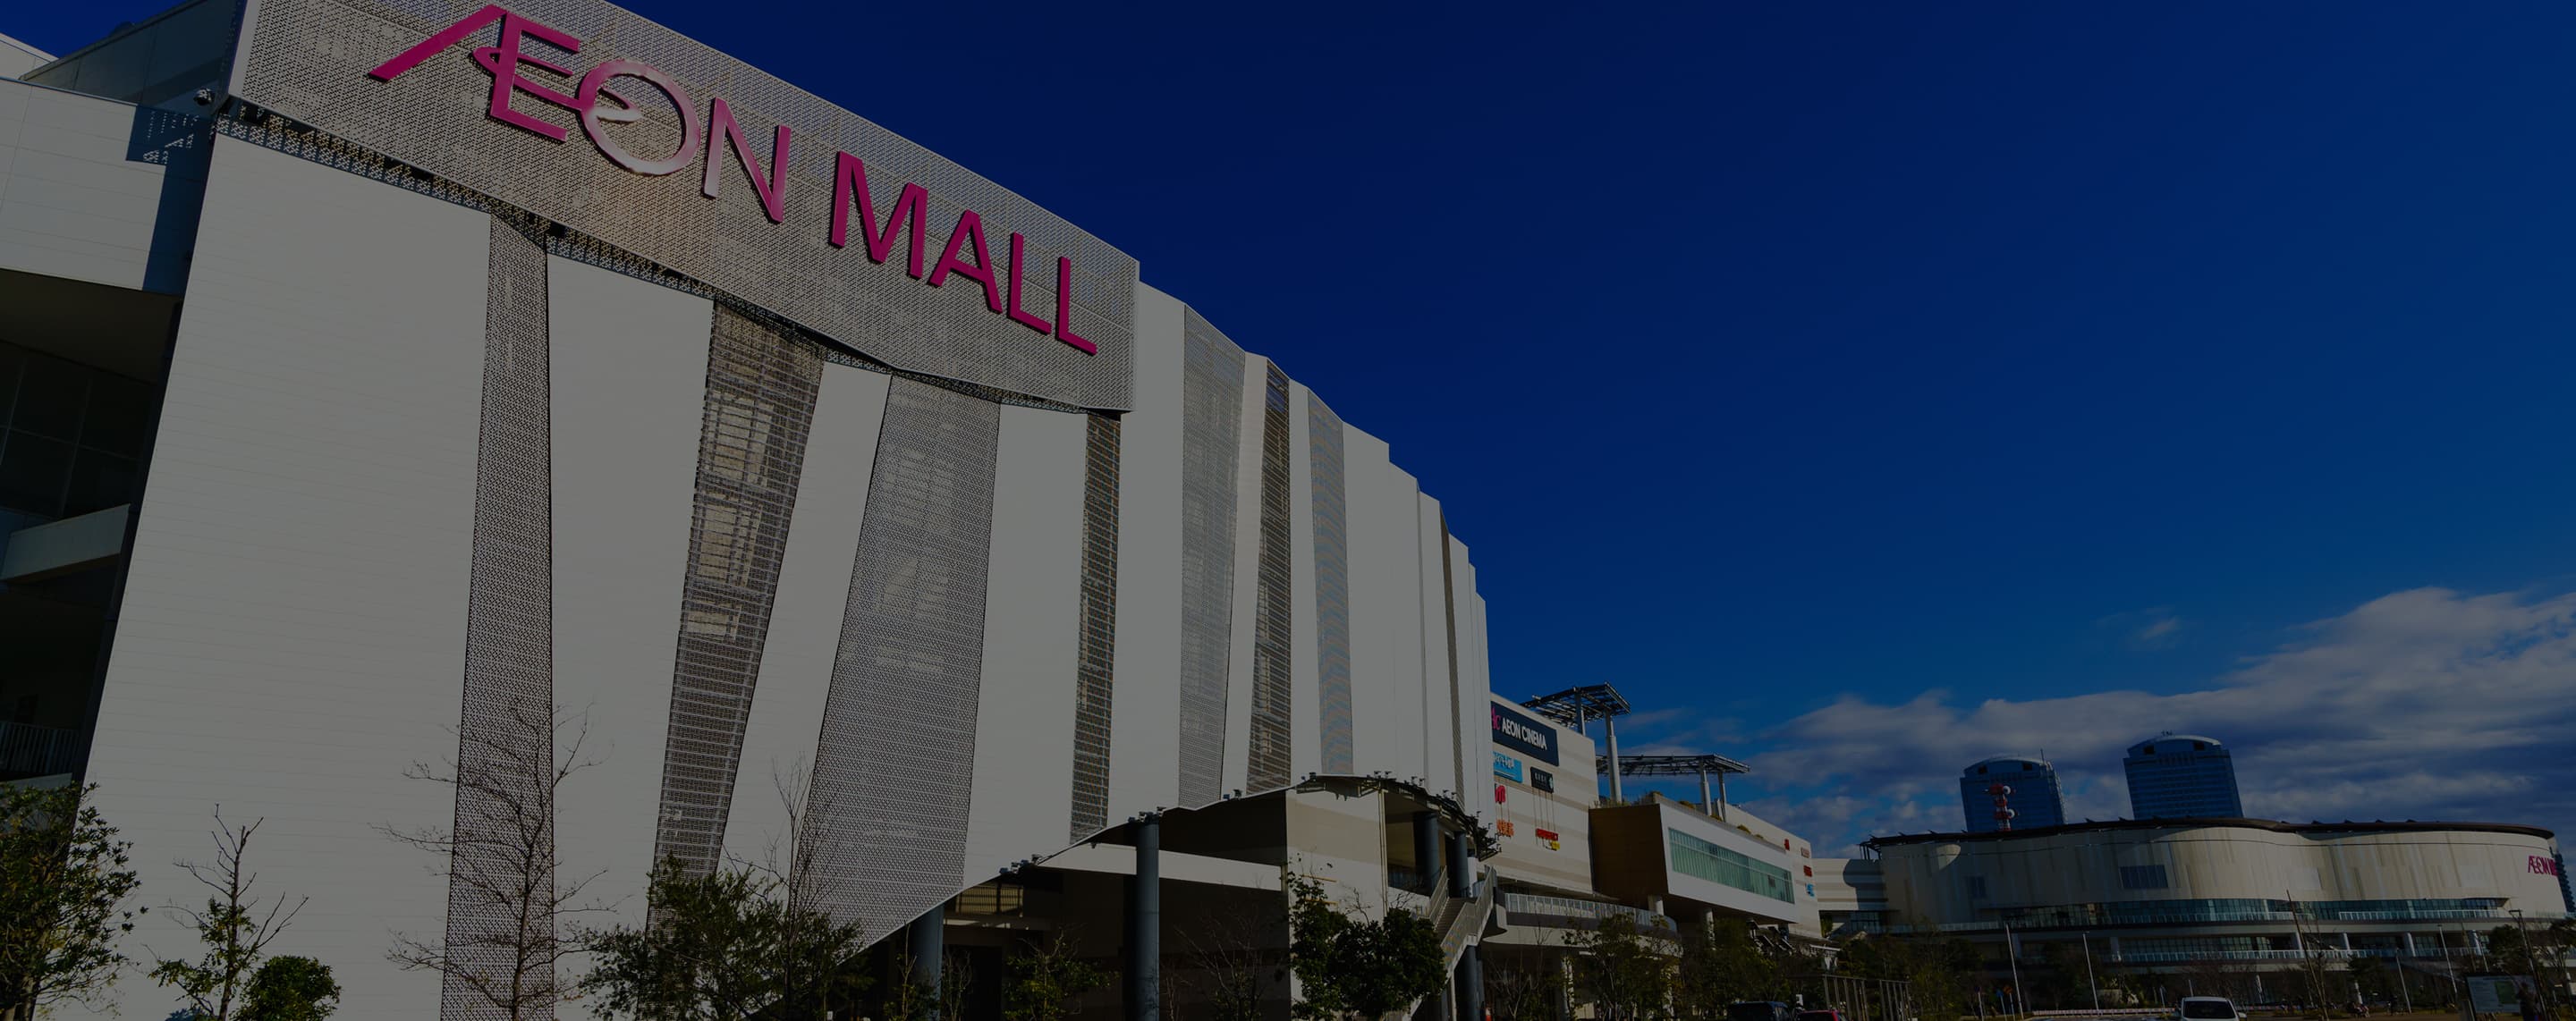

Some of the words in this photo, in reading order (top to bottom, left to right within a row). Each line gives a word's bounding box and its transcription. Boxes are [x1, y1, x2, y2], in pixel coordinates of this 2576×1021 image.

[368, 4, 792, 223] AEON
[828, 150, 1097, 356] MALL
[1503, 717, 1521, 739] AEON
[1521, 726, 1547, 750] CINEMA
